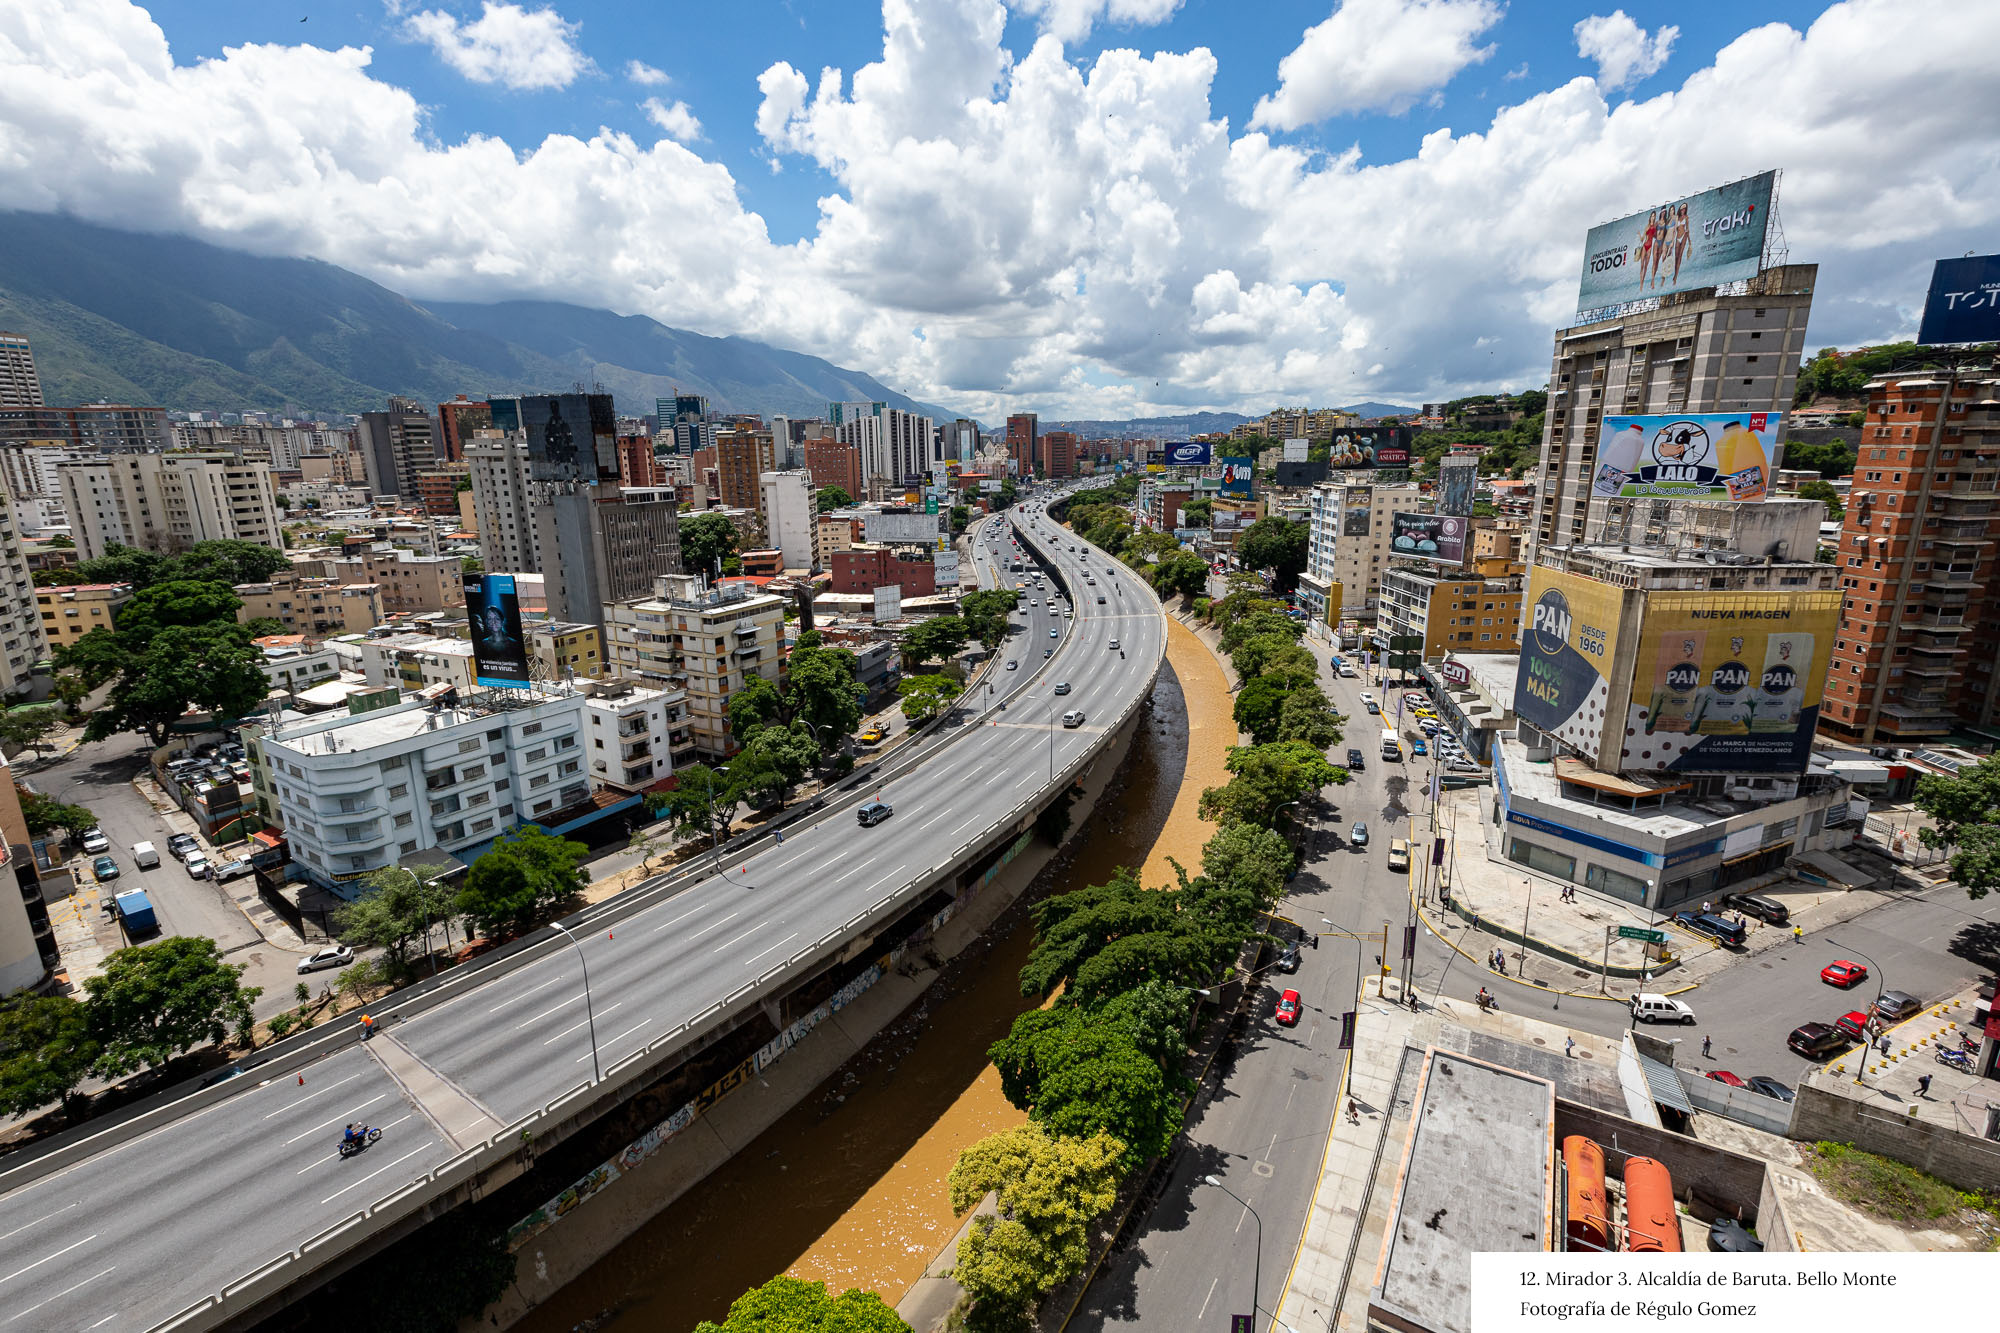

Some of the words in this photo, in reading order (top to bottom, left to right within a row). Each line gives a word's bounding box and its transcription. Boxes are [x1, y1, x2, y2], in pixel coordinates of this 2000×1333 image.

[1702, 204, 1755, 238] traki
[1591, 252, 1627, 274] TODO!
[1656, 466, 1698, 480] LALO
[1691, 610, 1736, 619] NUEVA
[1739, 610, 1791, 619] IMAGEN
[1581, 624, 1606, 641] DESDE
[1579, 636, 1605, 656] 1960
[1527, 676, 1560, 707] MAÍZ
